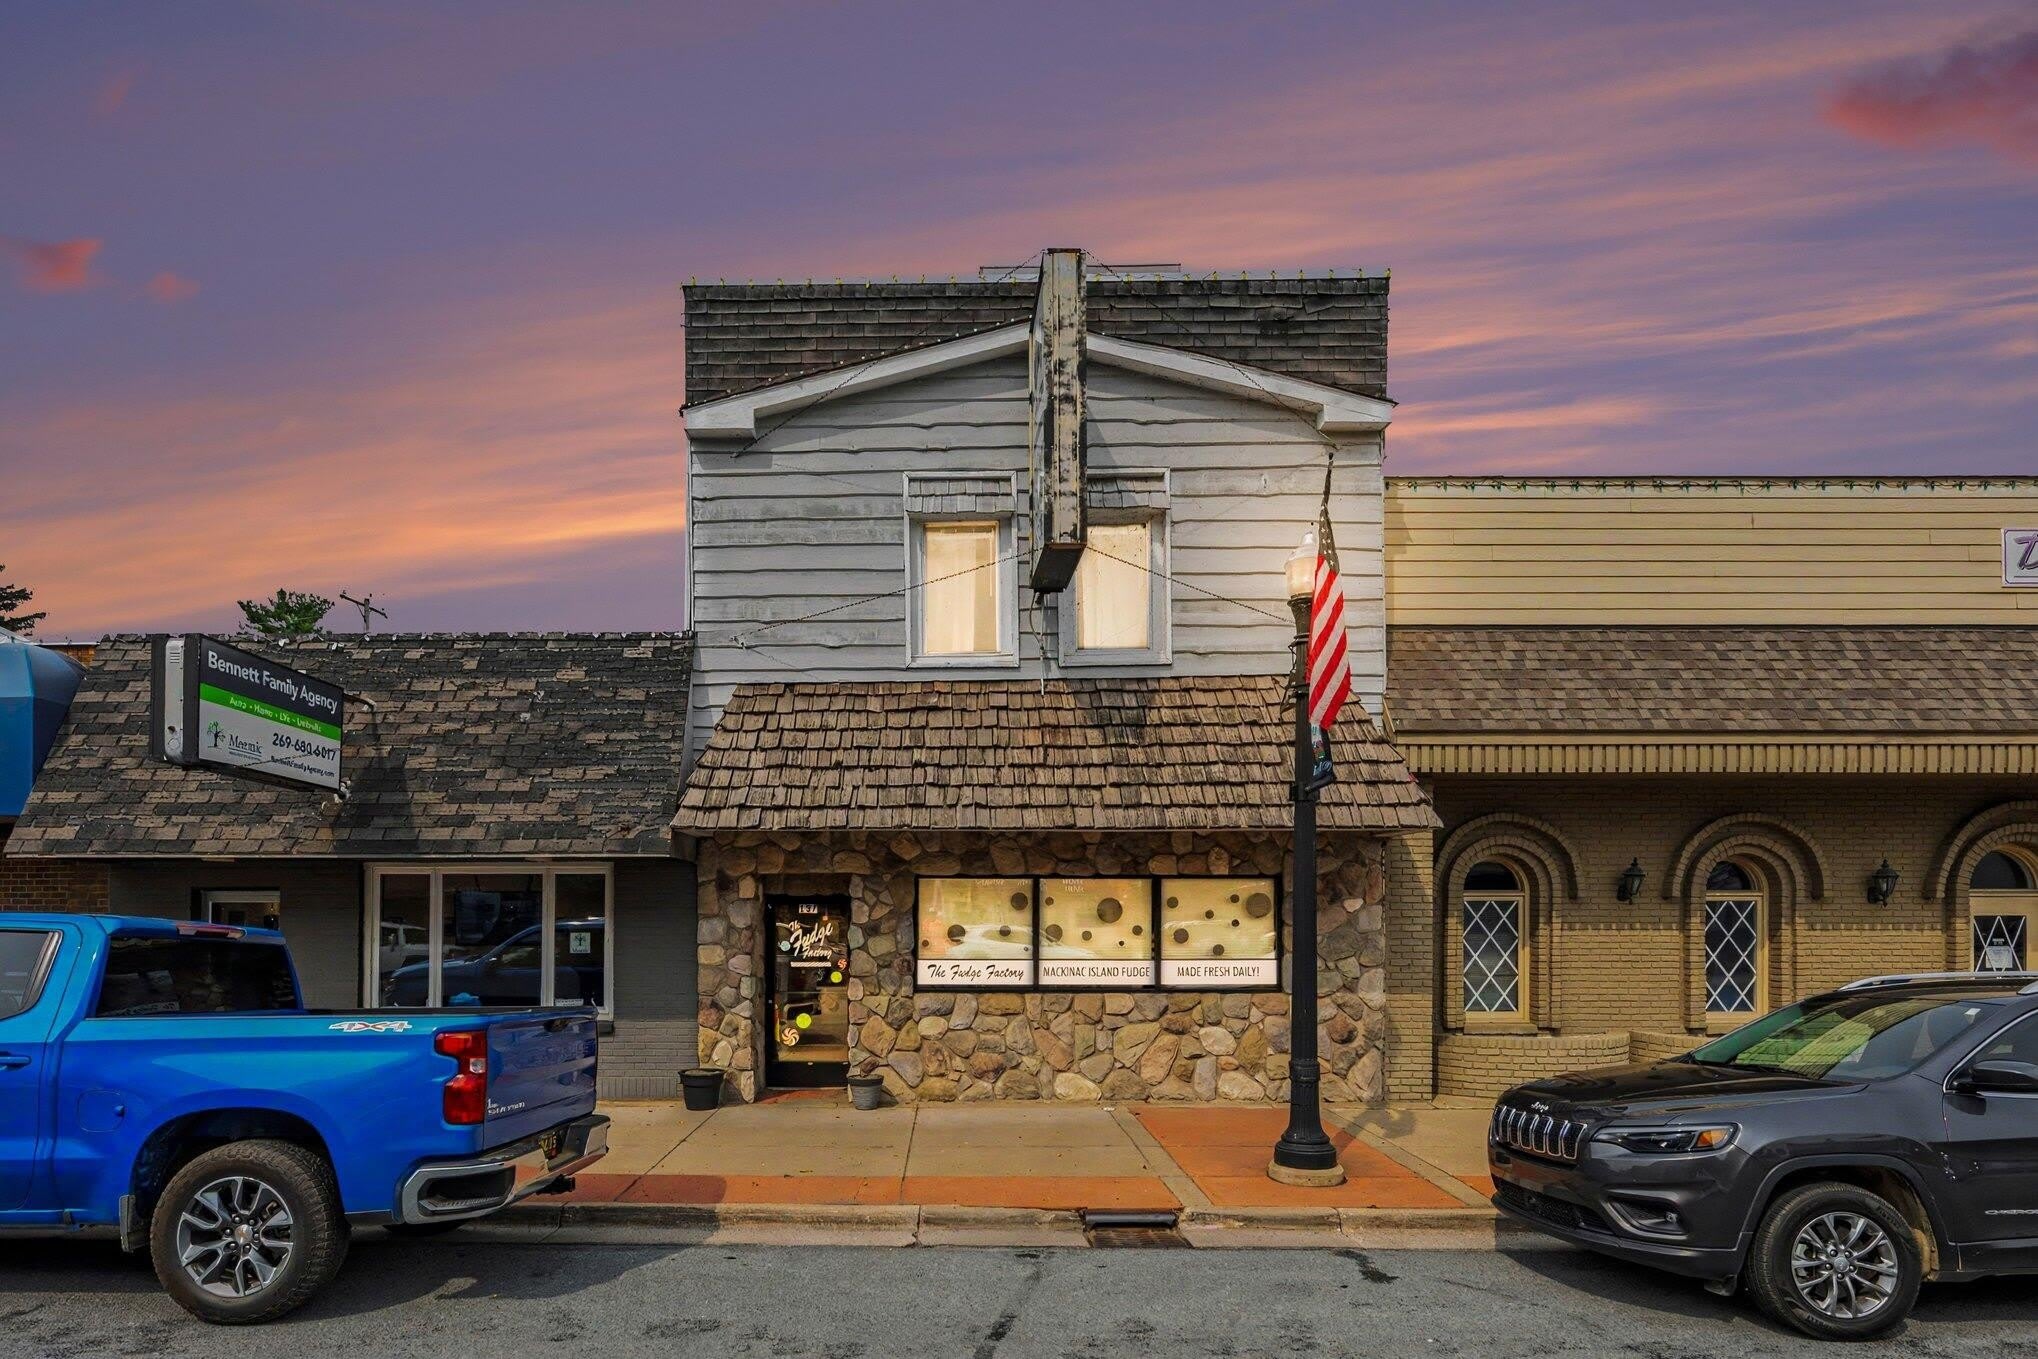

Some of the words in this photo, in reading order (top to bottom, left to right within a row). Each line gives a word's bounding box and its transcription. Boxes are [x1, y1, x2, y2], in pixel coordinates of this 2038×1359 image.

[208, 650, 260, 683] Bennett
[263, 670, 298, 701] Family
[300, 685, 338, 714] Agency
[790, 922, 833, 957] Fudge
[927, 964, 946, 978] The
[950, 964, 982, 981] Fudge
[986, 964, 1024, 981] Factory
[1043, 966, 1086, 977] MACKINAC
[1088, 966, 1119, 977] ISLAND
[1121, 966, 1150, 977] FUDGE
[1177, 966, 1202, 977] MADE
[1204, 966, 1230, 977] FRESH
[1233, 966, 1260, 977] DAILY!
